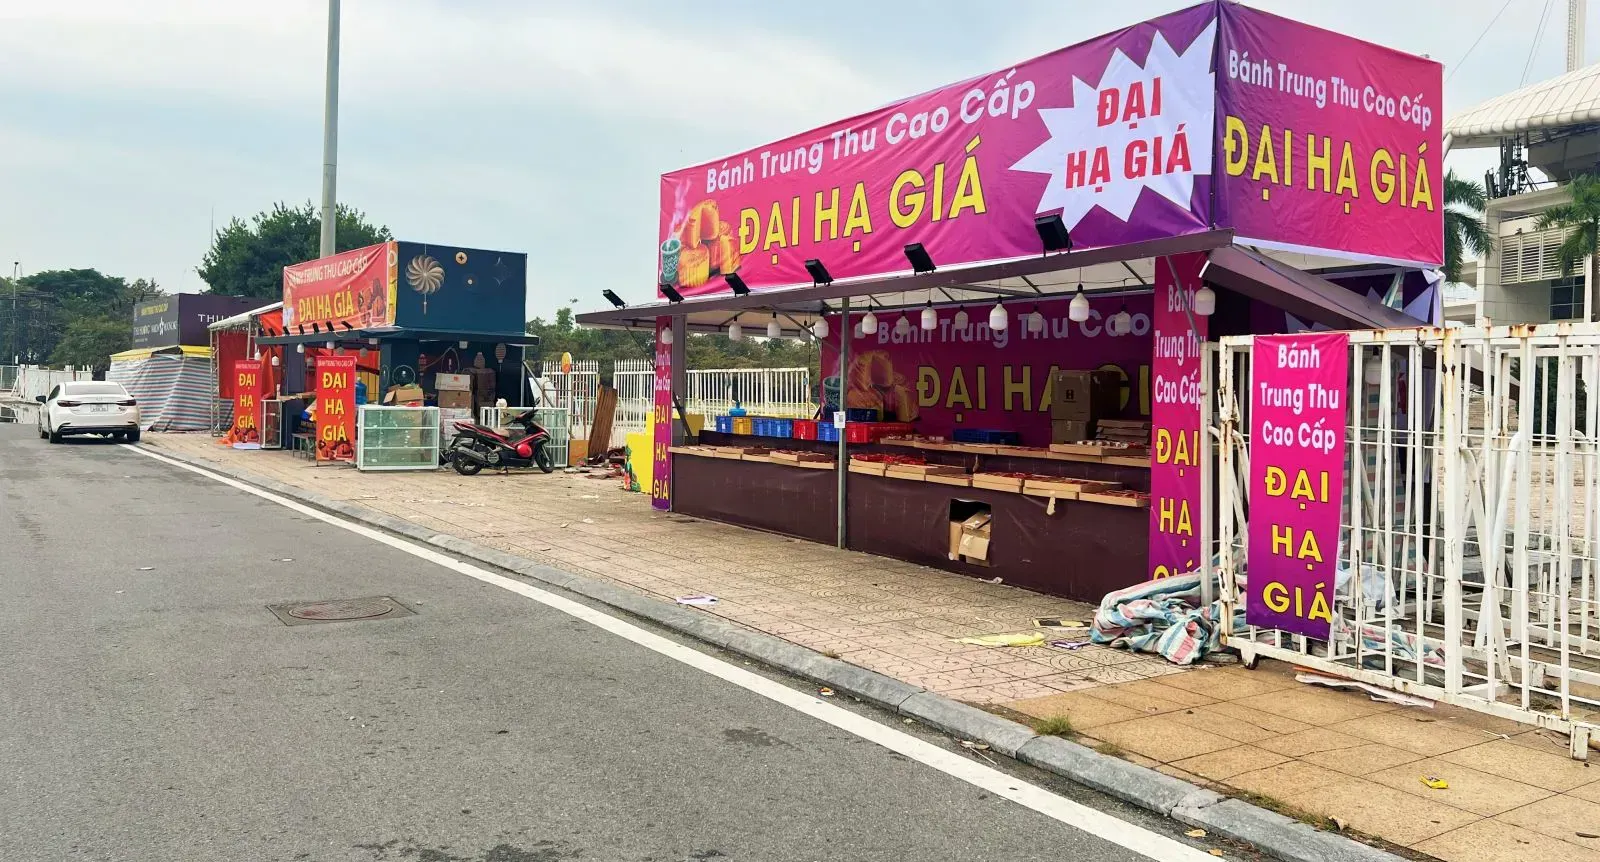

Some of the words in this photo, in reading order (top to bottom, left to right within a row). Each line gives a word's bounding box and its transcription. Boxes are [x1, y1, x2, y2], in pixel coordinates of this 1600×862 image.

[1096, 76, 1161, 130] ĐẠI
[1229, 49, 1273, 89] Bánh
[1277, 63, 1327, 109] Trung
[1330, 76, 1359, 109] Thu
[1363, 88, 1395, 118] Cao
[1399, 91, 1433, 132] Cấp
[706, 158, 754, 194] Bánh
[760, 142, 824, 175] Trung
[831, 127, 876, 160] Thu
[885, 105, 950, 145] Cao
[959, 68, 1036, 124] Cấp
[1065, 148, 1111, 194] HẠ
[1123, 123, 1192, 180] GIÁ
[1223, 115, 1292, 201] ĐẠI
[1307, 132, 1359, 215] HẠ
[1369, 140, 1435, 212] GIÁ
[738, 196, 801, 264] ĐẠI
[814, 182, 873, 253] HẠ
[888, 134, 987, 229] GIÁ
[324, 263, 336, 279] THU
[337, 259, 351, 276] CAO
[334, 285, 354, 317] GIÁ
[940, 318, 1008, 349] Trung
[1017, 313, 1069, 340] Thu
[1079, 309, 1150, 338] Cao
[1155, 330, 1184, 366] Trung
[1187, 330, 1206, 358] Th
[1277, 342, 1320, 369] Bánh
[239, 373, 256, 390] ĐẠI
[323, 372, 347, 393] ĐẠI
[916, 365, 986, 423] ĐẠI
[1155, 375, 1177, 403] Cao
[1260, 382, 1304, 415] Trung
[1308, 383, 1339, 410] Thu
[240, 394, 254, 411] HẠ
[325, 399, 345, 419] HẠ
[655, 405, 669, 430] ĐẠI
[238, 413, 255, 429] GIÁ
[323, 422, 347, 441] GIÁ
[1262, 420, 1293, 447] Cao
[1298, 417, 1336, 455] Cấp
[655, 442, 667, 467] HẠ
[1156, 428, 1199, 477] ĐẠI
[653, 476, 669, 500] GIÁ
[1265, 466, 1329, 510] ĐẠI
[1159, 497, 1193, 547] HẠ
[1271, 524, 1323, 571] HẠ
[1262, 581, 1334, 625] GIÁ
